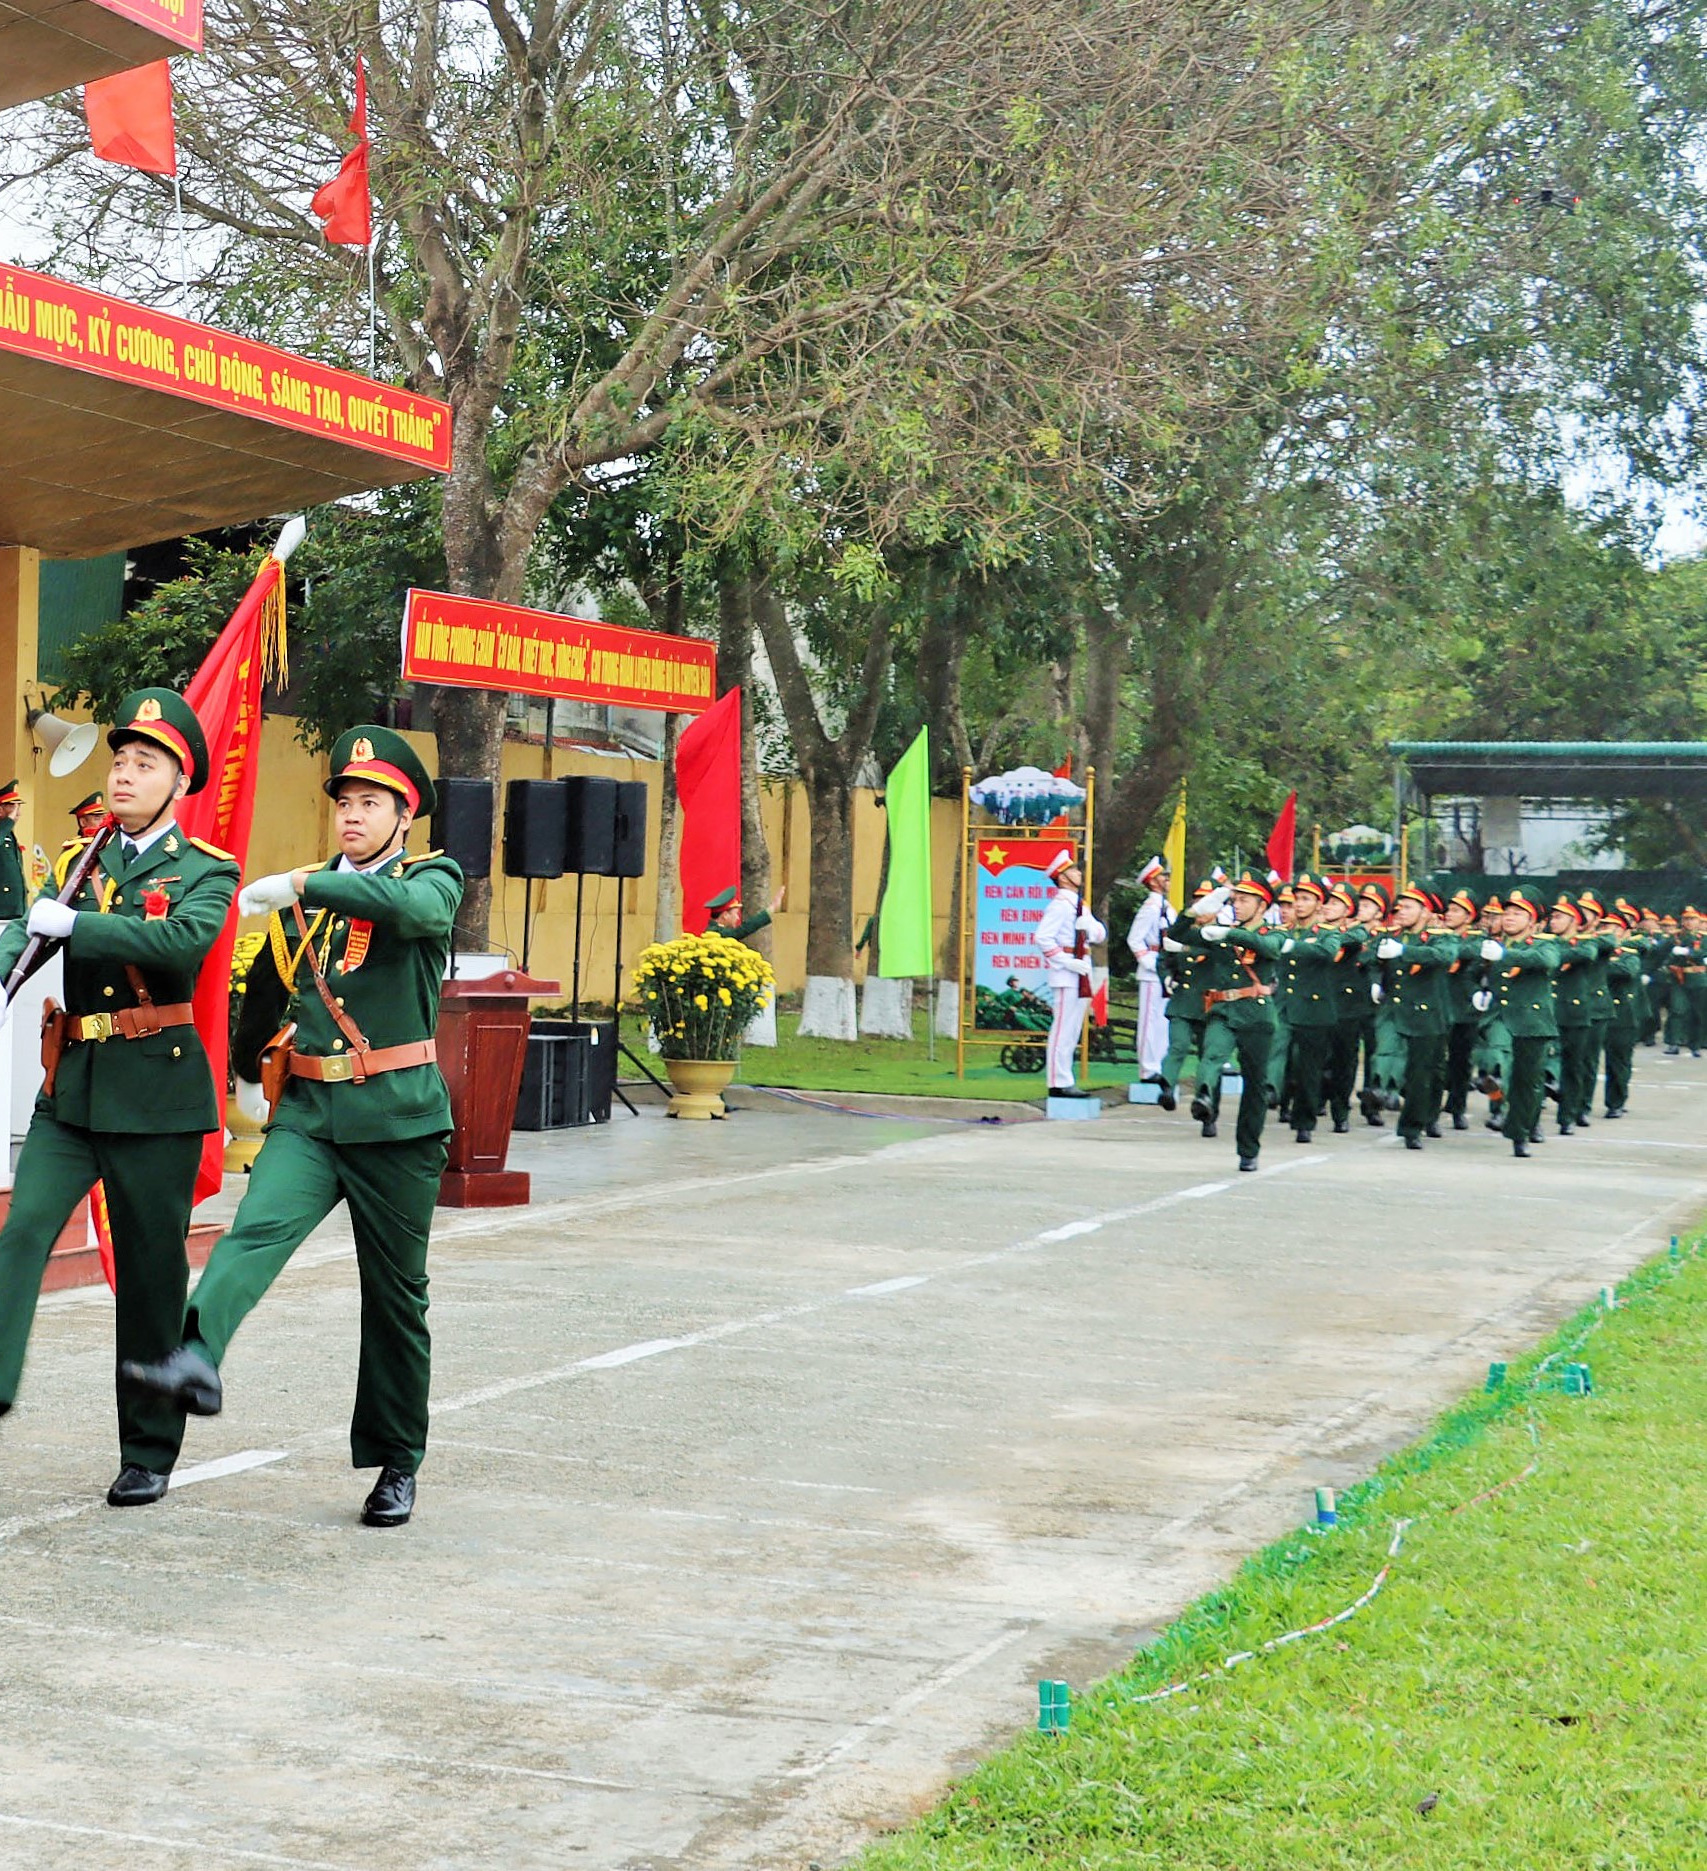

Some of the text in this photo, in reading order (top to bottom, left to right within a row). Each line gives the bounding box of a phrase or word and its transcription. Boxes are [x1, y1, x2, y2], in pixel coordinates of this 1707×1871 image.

[35, 300, 84, 352] MỰC,
[88, 305, 111, 356] KỶ
[116, 324, 180, 381] CƯƠNG,
[184, 339, 217, 386] CHỦ
[220, 353, 267, 405] ĐỘNG,
[271, 368, 311, 415] SÁNG
[314, 385, 345, 429] TẠO,
[348, 394, 389, 439] QUYẾT
